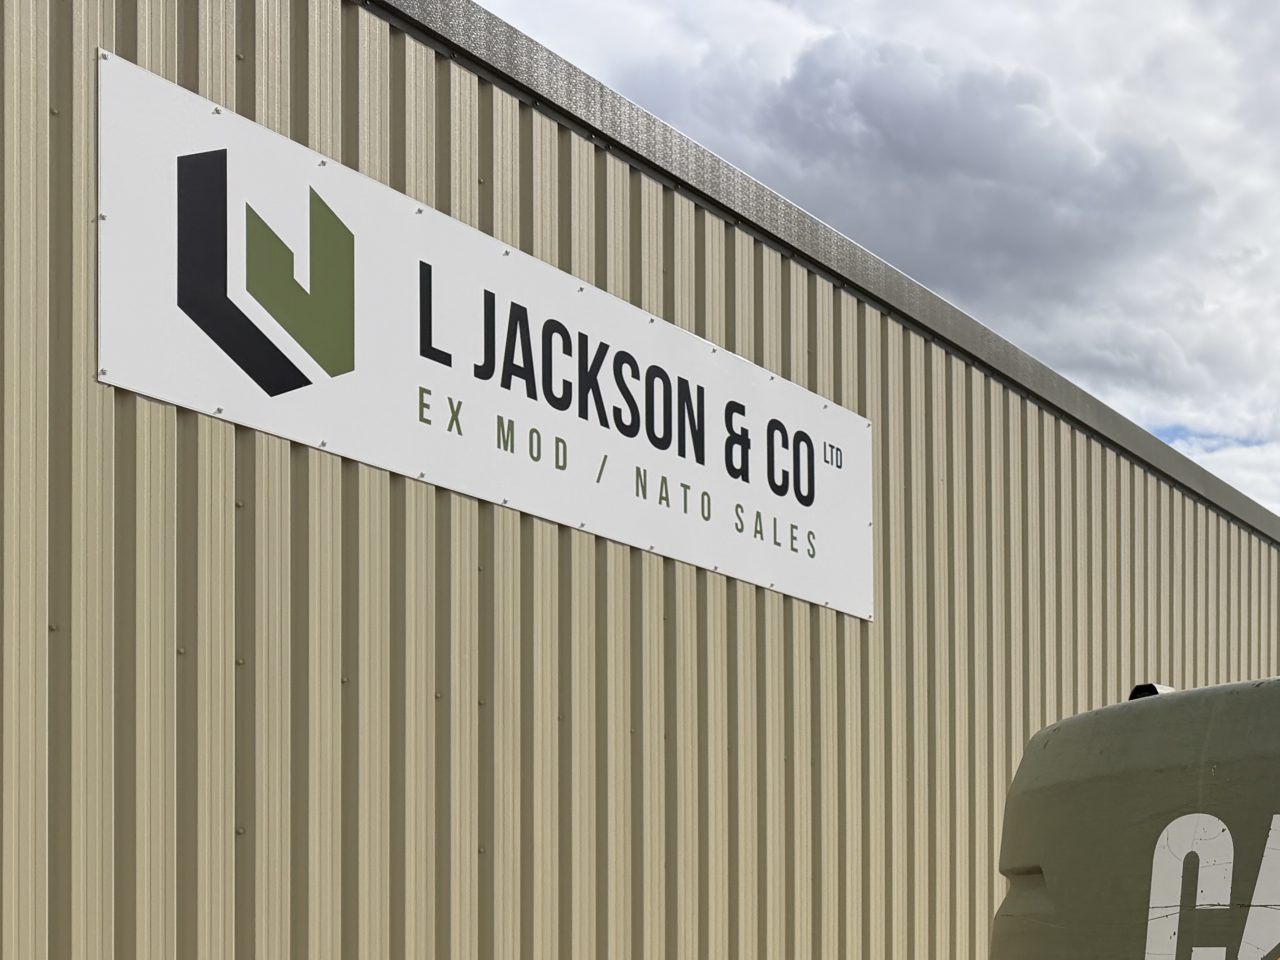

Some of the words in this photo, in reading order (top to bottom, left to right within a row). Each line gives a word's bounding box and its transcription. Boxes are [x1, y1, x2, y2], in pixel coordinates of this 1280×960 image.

[418, 386, 463, 437] EX
[496, 414, 568, 471] MOD
[635, 465, 712, 522] NATO
[734, 503, 816, 559] SALES
[419, 260, 453, 368] L
[473, 288, 706, 466] JACKSON
[724, 400, 752, 484] &
[766, 418, 816, 508] CO
[823, 441, 844, 470] LTD
